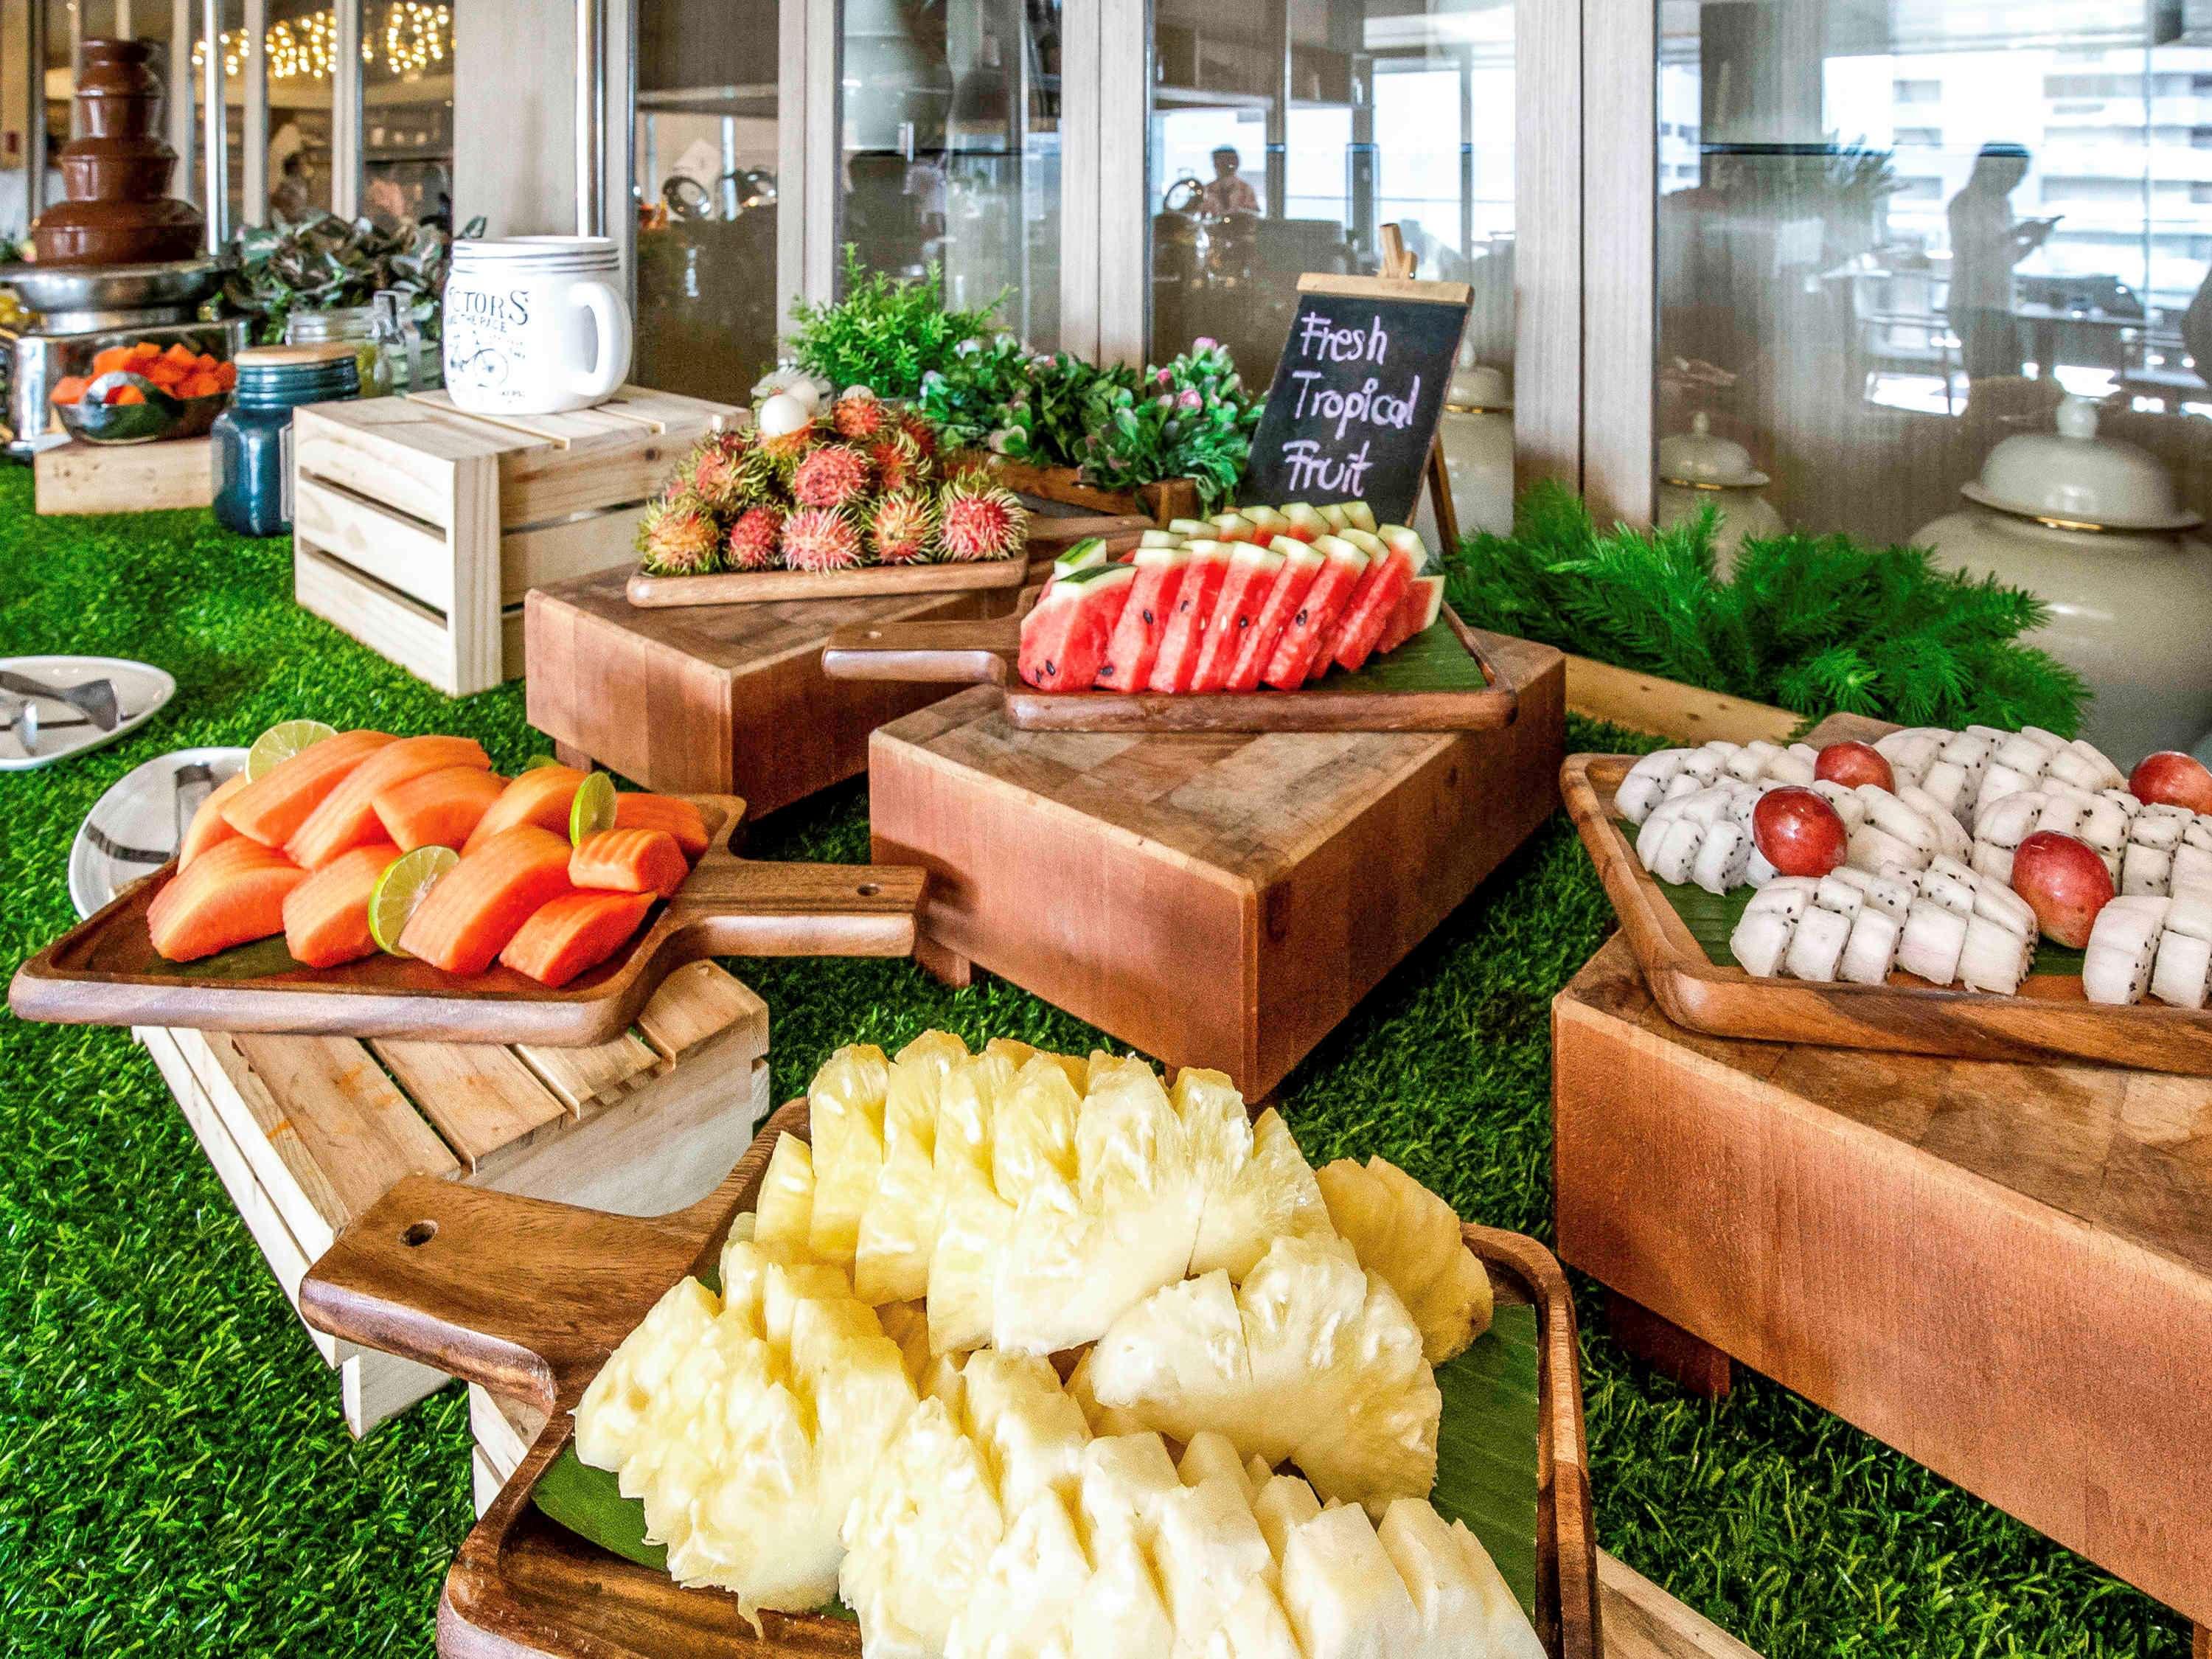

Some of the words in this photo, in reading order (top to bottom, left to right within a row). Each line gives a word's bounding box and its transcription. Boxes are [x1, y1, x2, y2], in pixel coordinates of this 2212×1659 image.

[1300, 311, 1388, 365] Fresh
[1292, 371, 1421, 440] Tropical
[1282, 439, 1374, 498] Fruit
